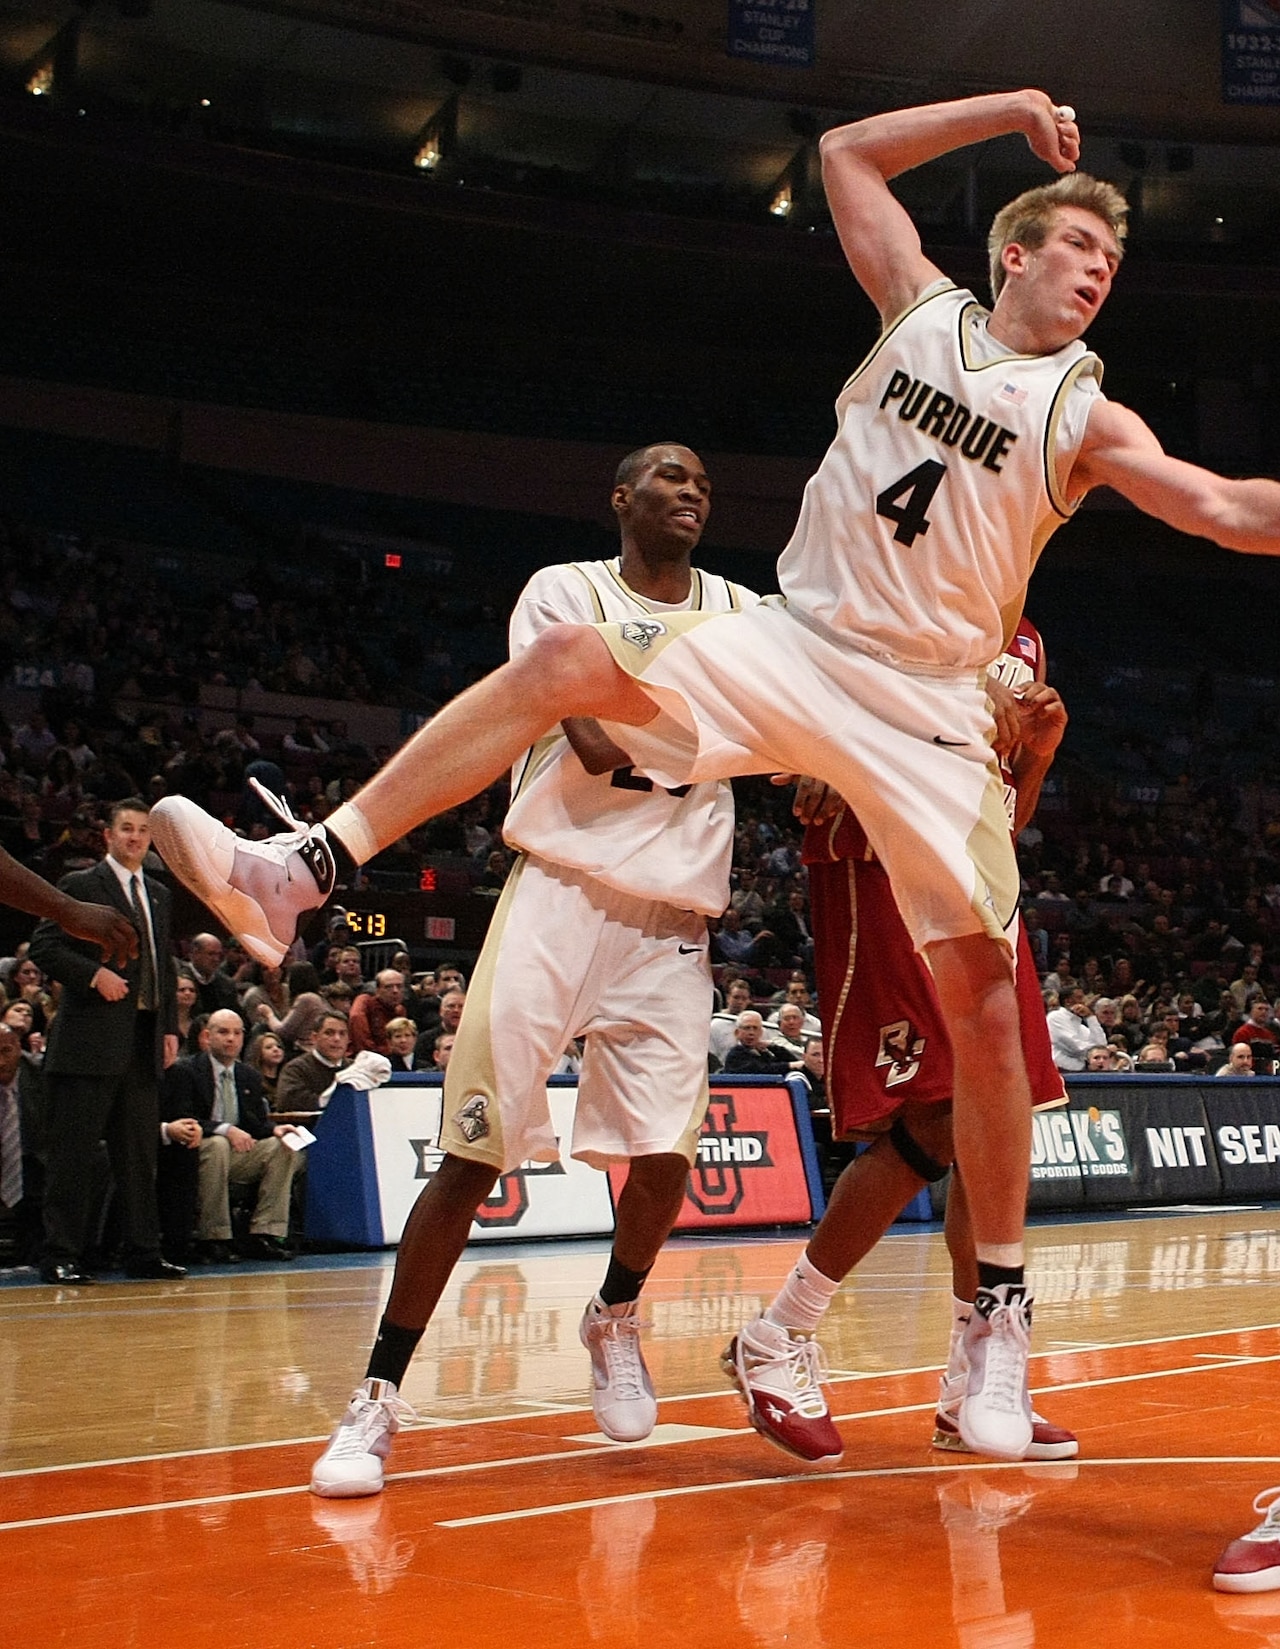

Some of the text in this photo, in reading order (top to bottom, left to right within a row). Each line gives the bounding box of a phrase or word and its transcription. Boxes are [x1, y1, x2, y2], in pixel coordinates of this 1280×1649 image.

[879, 369, 1018, 474] PURDUE
[876, 458, 947, 548] 4
[1032, 1163, 1128, 1179] SPORTING GOODS
[1147, 1126, 1208, 1168] NIT
